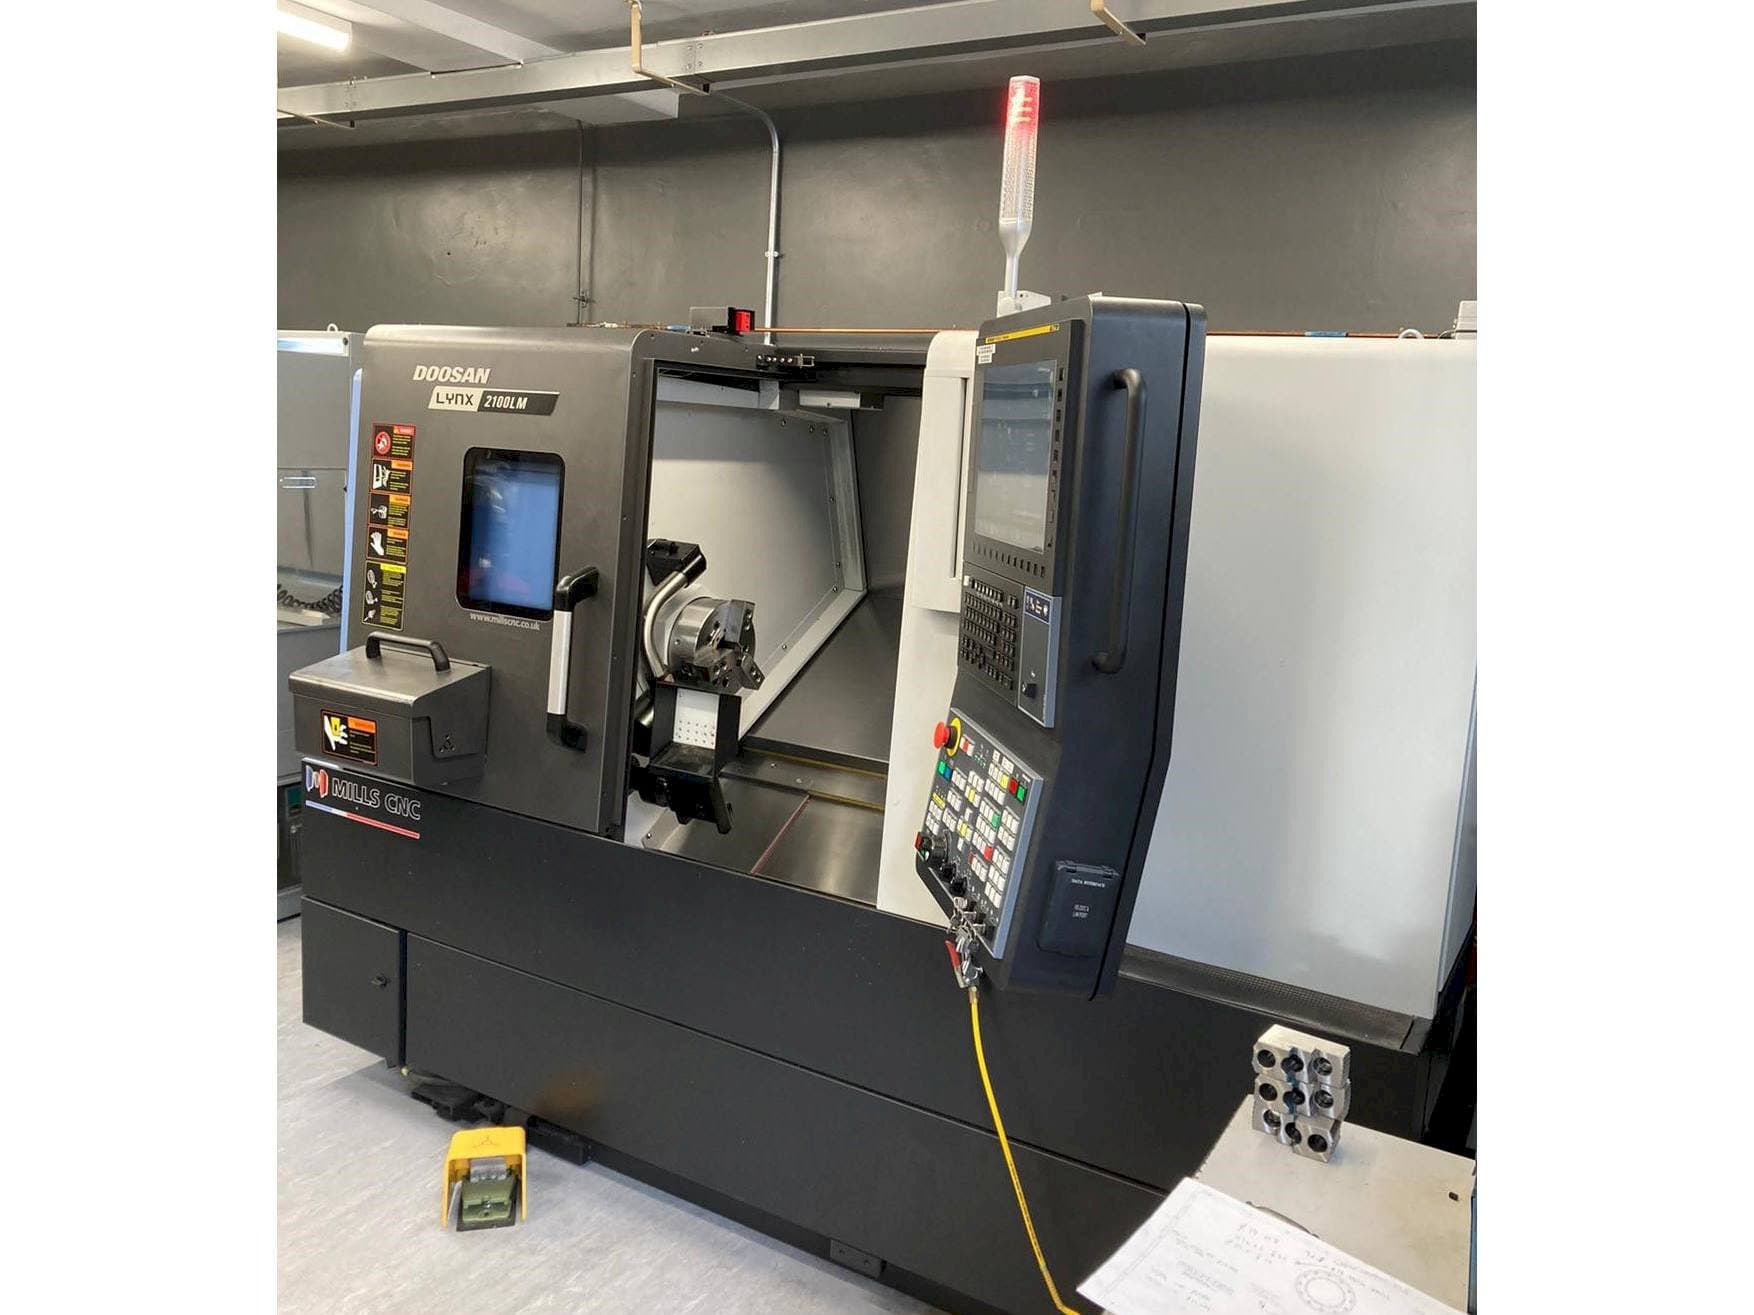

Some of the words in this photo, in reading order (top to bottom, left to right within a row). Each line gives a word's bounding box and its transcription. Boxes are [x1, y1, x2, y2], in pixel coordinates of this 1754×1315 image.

[413, 365, 492, 384] DOOSAN
[484, 395, 528, 409] 2100LM
[469, 612, 540, 631] www.millscnc.co.uk
[332, 777, 380, 808] MILLS
[384, 793, 421, 820] CNC
